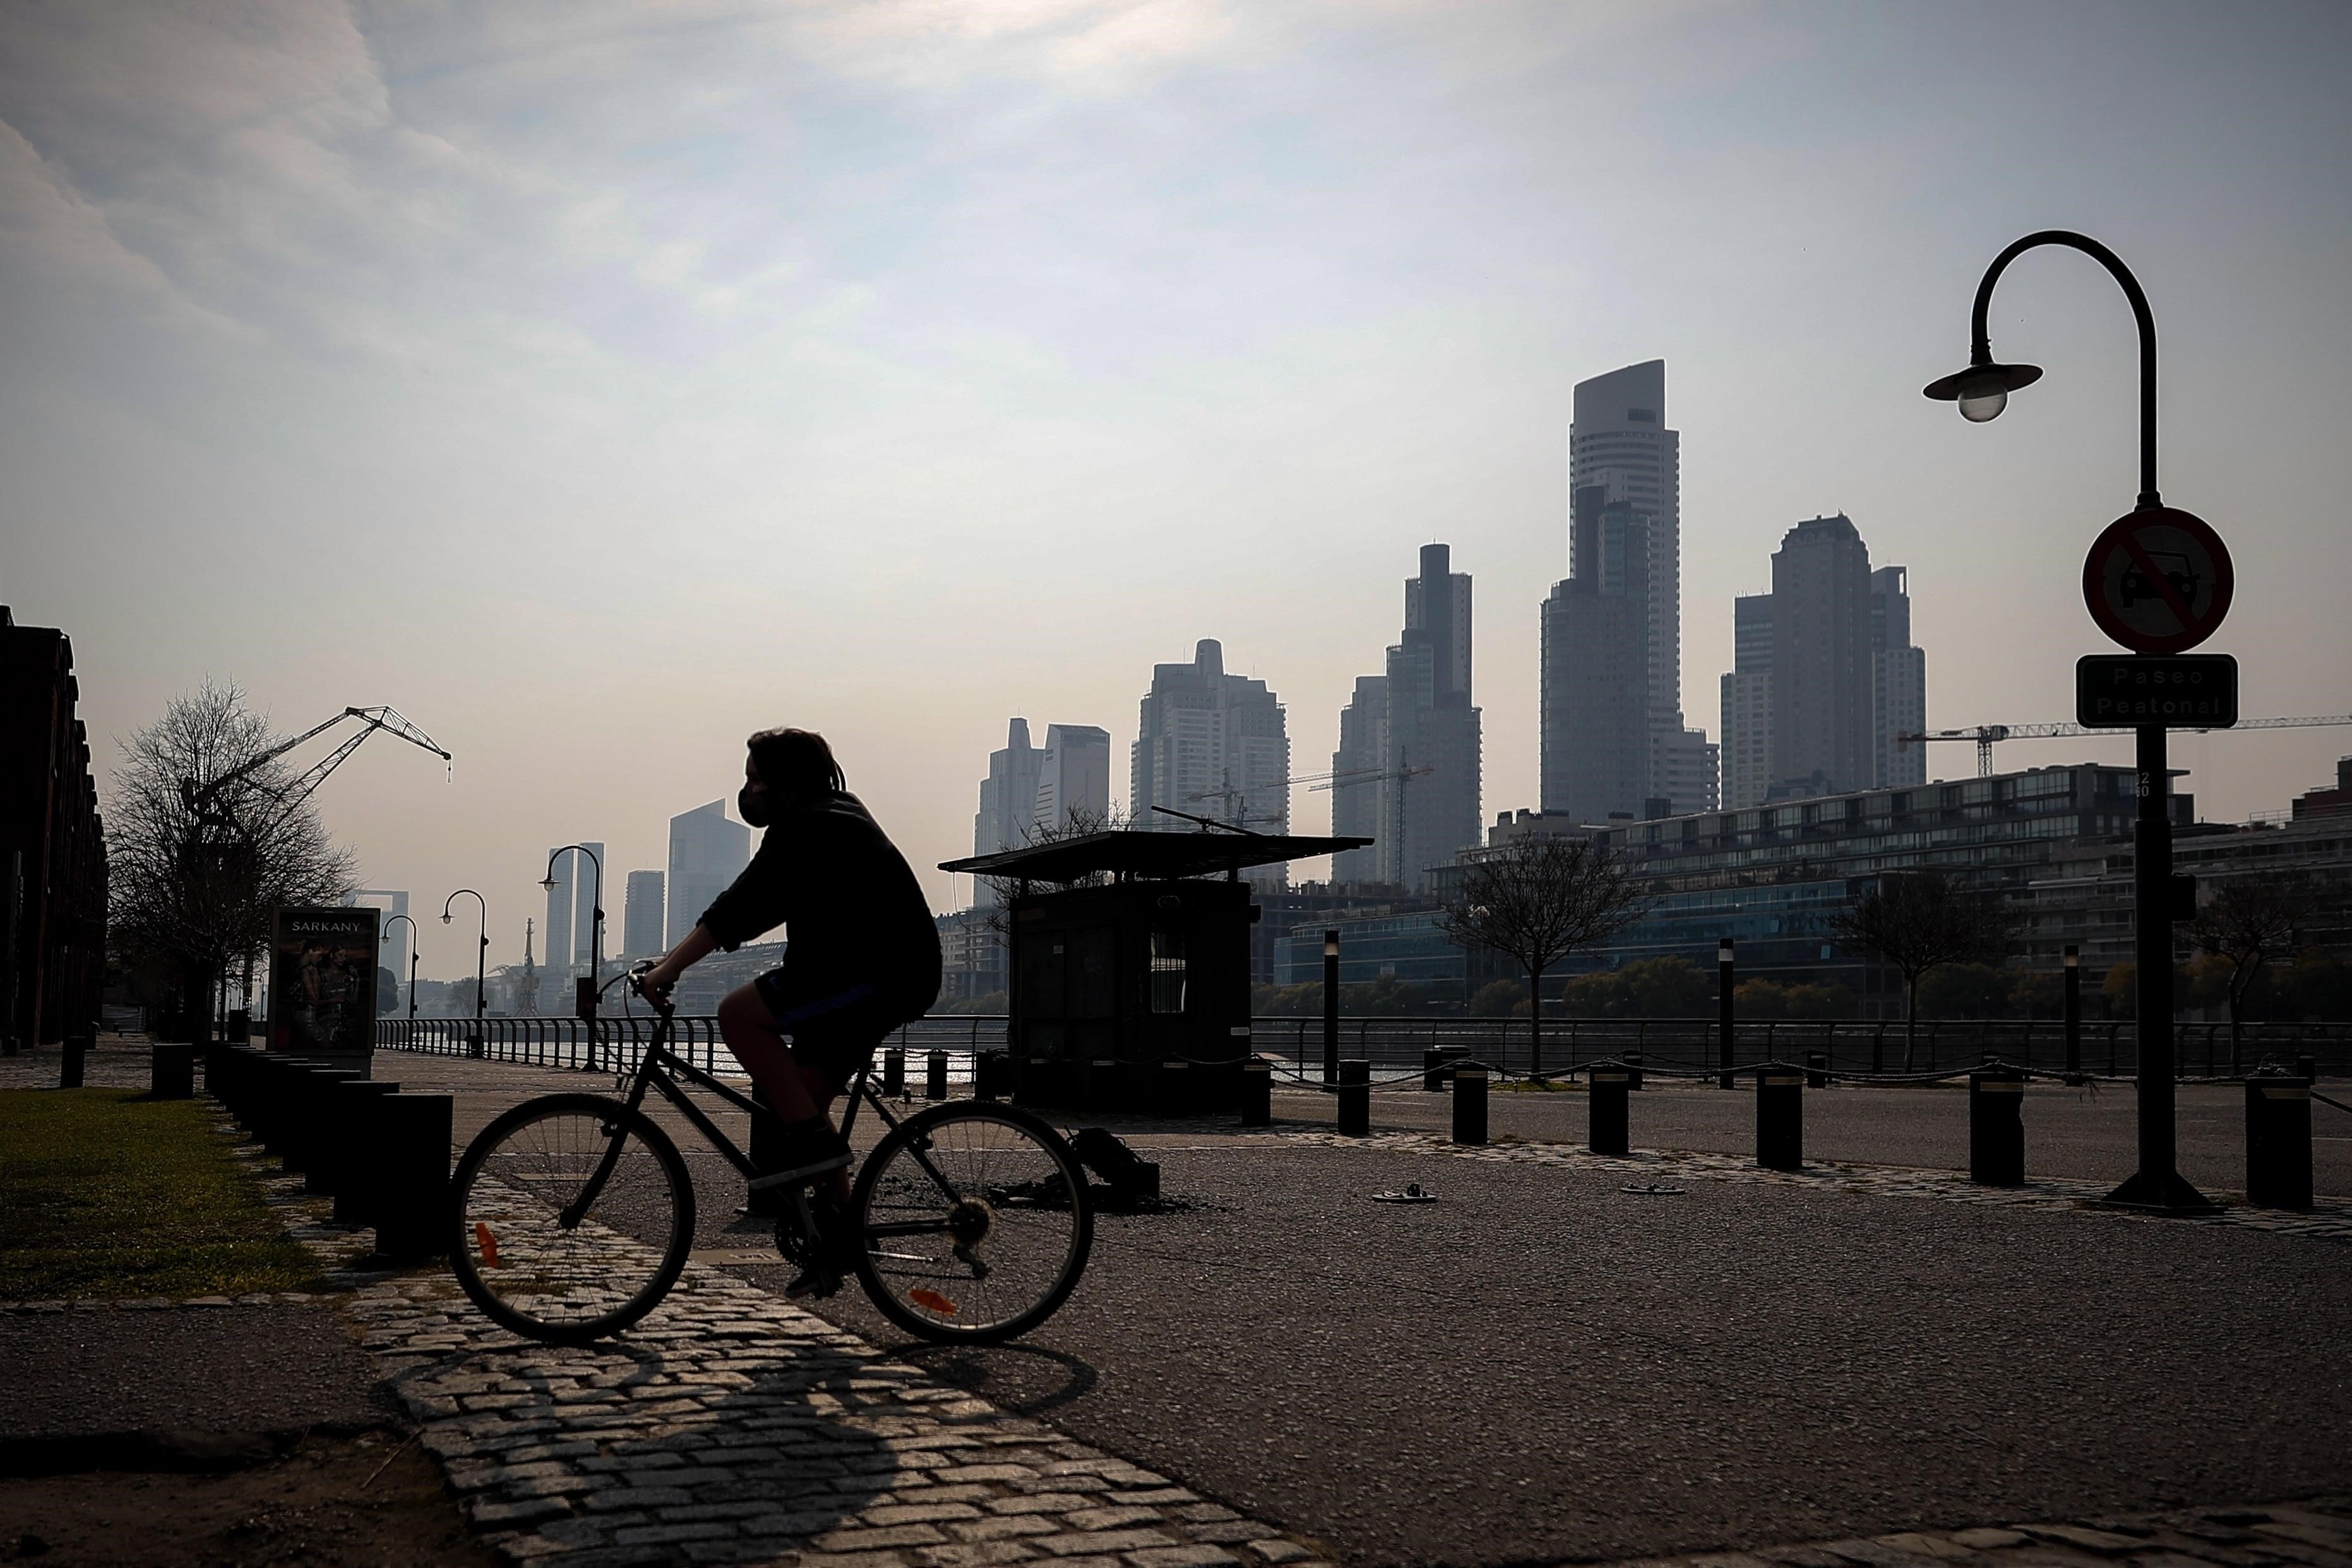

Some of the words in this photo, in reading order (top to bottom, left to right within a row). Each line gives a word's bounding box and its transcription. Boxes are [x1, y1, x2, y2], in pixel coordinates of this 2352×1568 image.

[2111, 667, 2203, 685] Paseo
[2096, 696, 2220, 715] Peatonal
[292, 921, 361, 932] SARKANY
